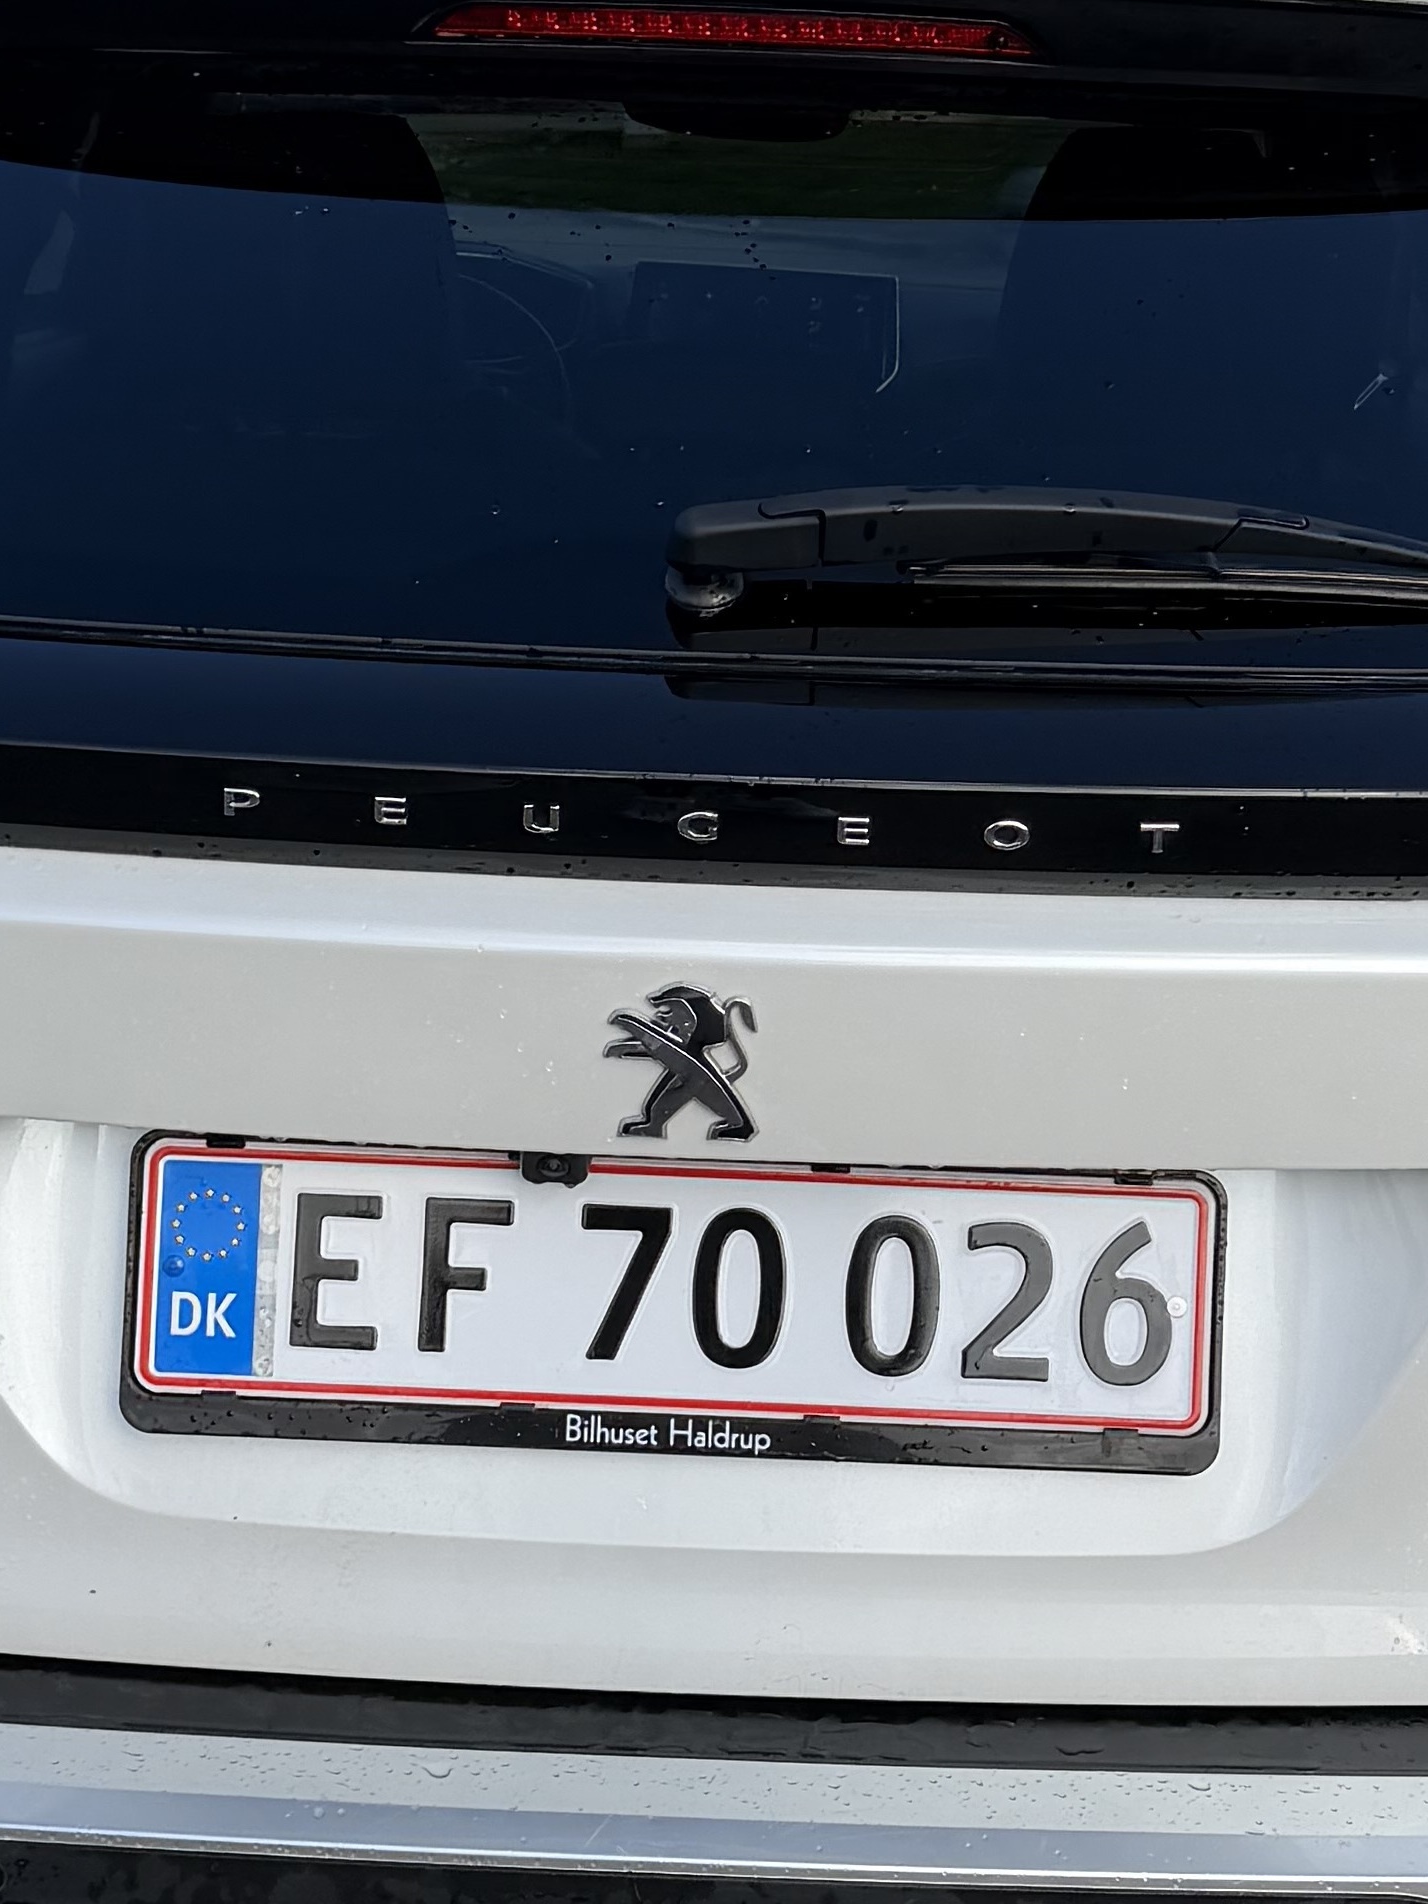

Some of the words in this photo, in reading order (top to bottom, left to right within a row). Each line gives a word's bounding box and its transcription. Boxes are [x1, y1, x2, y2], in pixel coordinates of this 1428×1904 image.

[222, 786, 1181, 854] PEUGEOT
[169, 1291, 238, 1339] DK
[288, 1192, 515, 1353] EF
[581, 1203, 789, 1370] 70
[844, 1214, 1174, 1388] 026
[565, 1413, 658, 1447] Bilhuset
[669, 1417, 771, 1456] Haldrup
